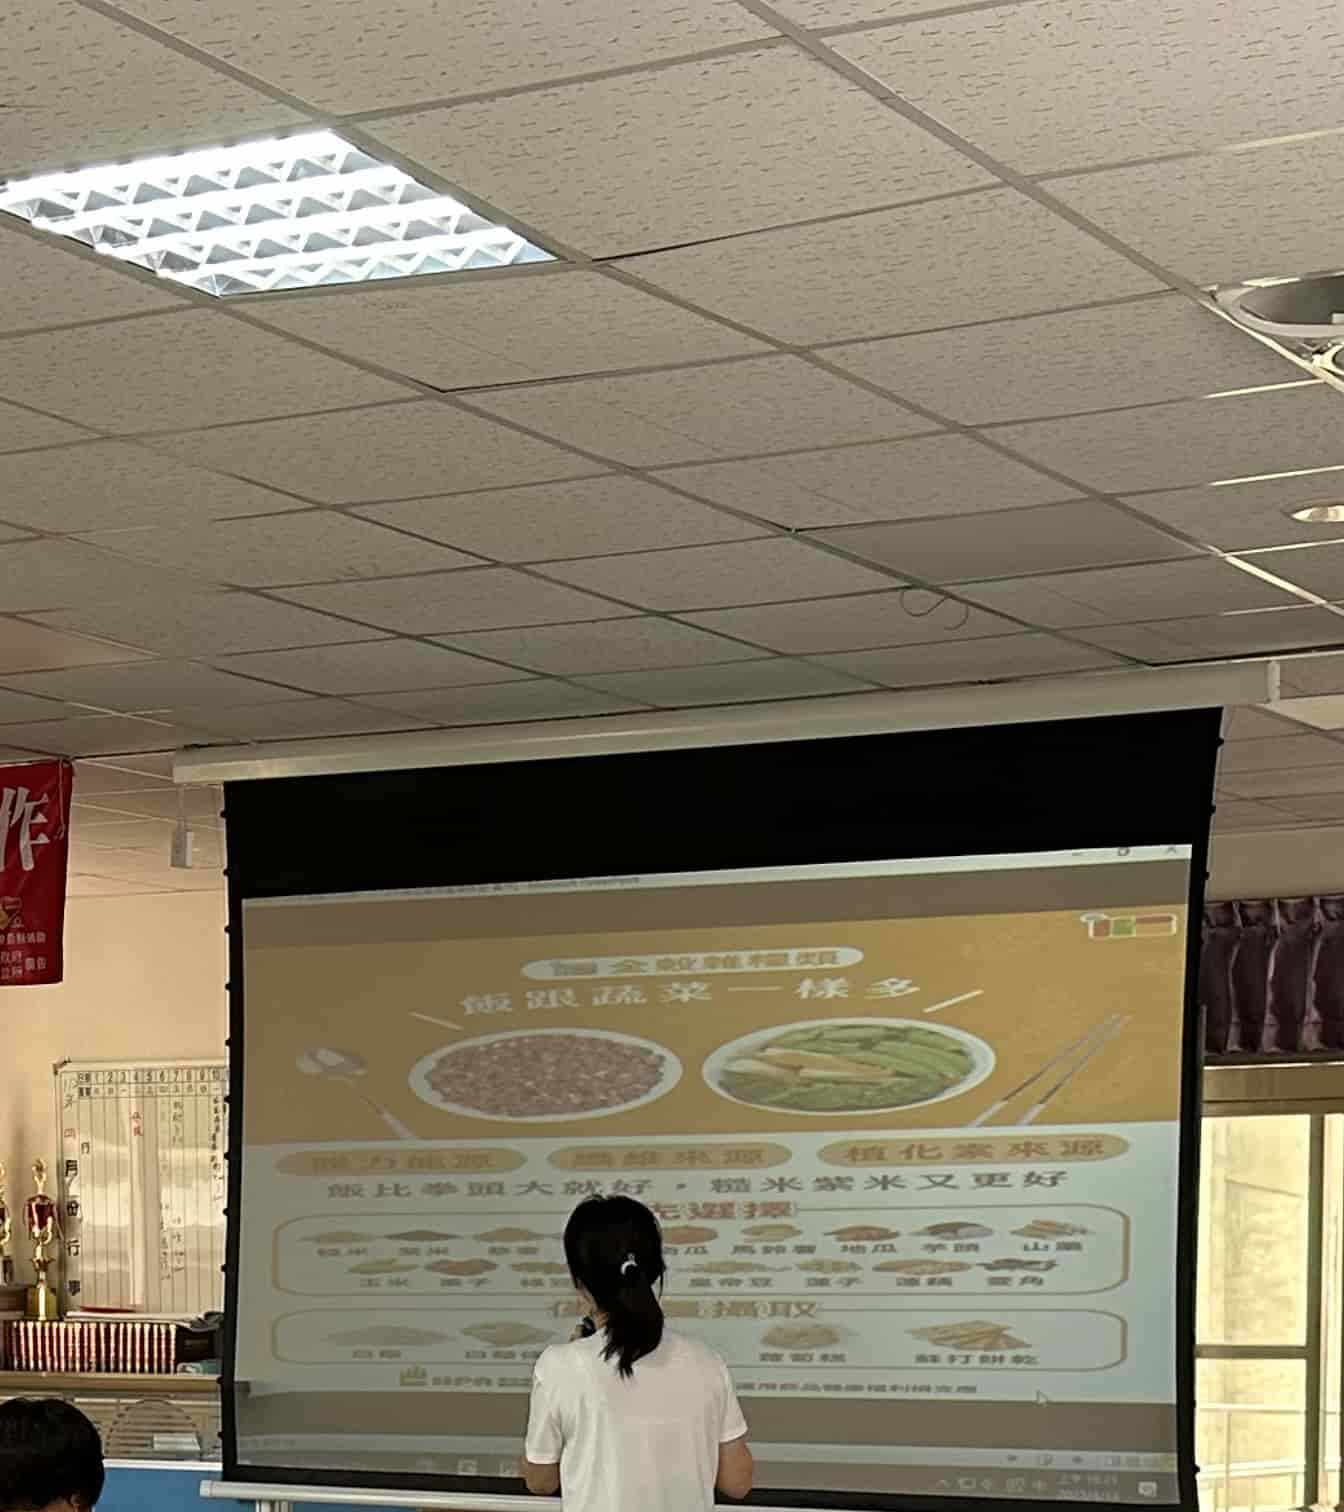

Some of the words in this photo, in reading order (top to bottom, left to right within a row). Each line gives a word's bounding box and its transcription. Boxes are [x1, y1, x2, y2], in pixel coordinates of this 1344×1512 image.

[459, 976, 920, 1016] 飯跟蔬菜一樣多
